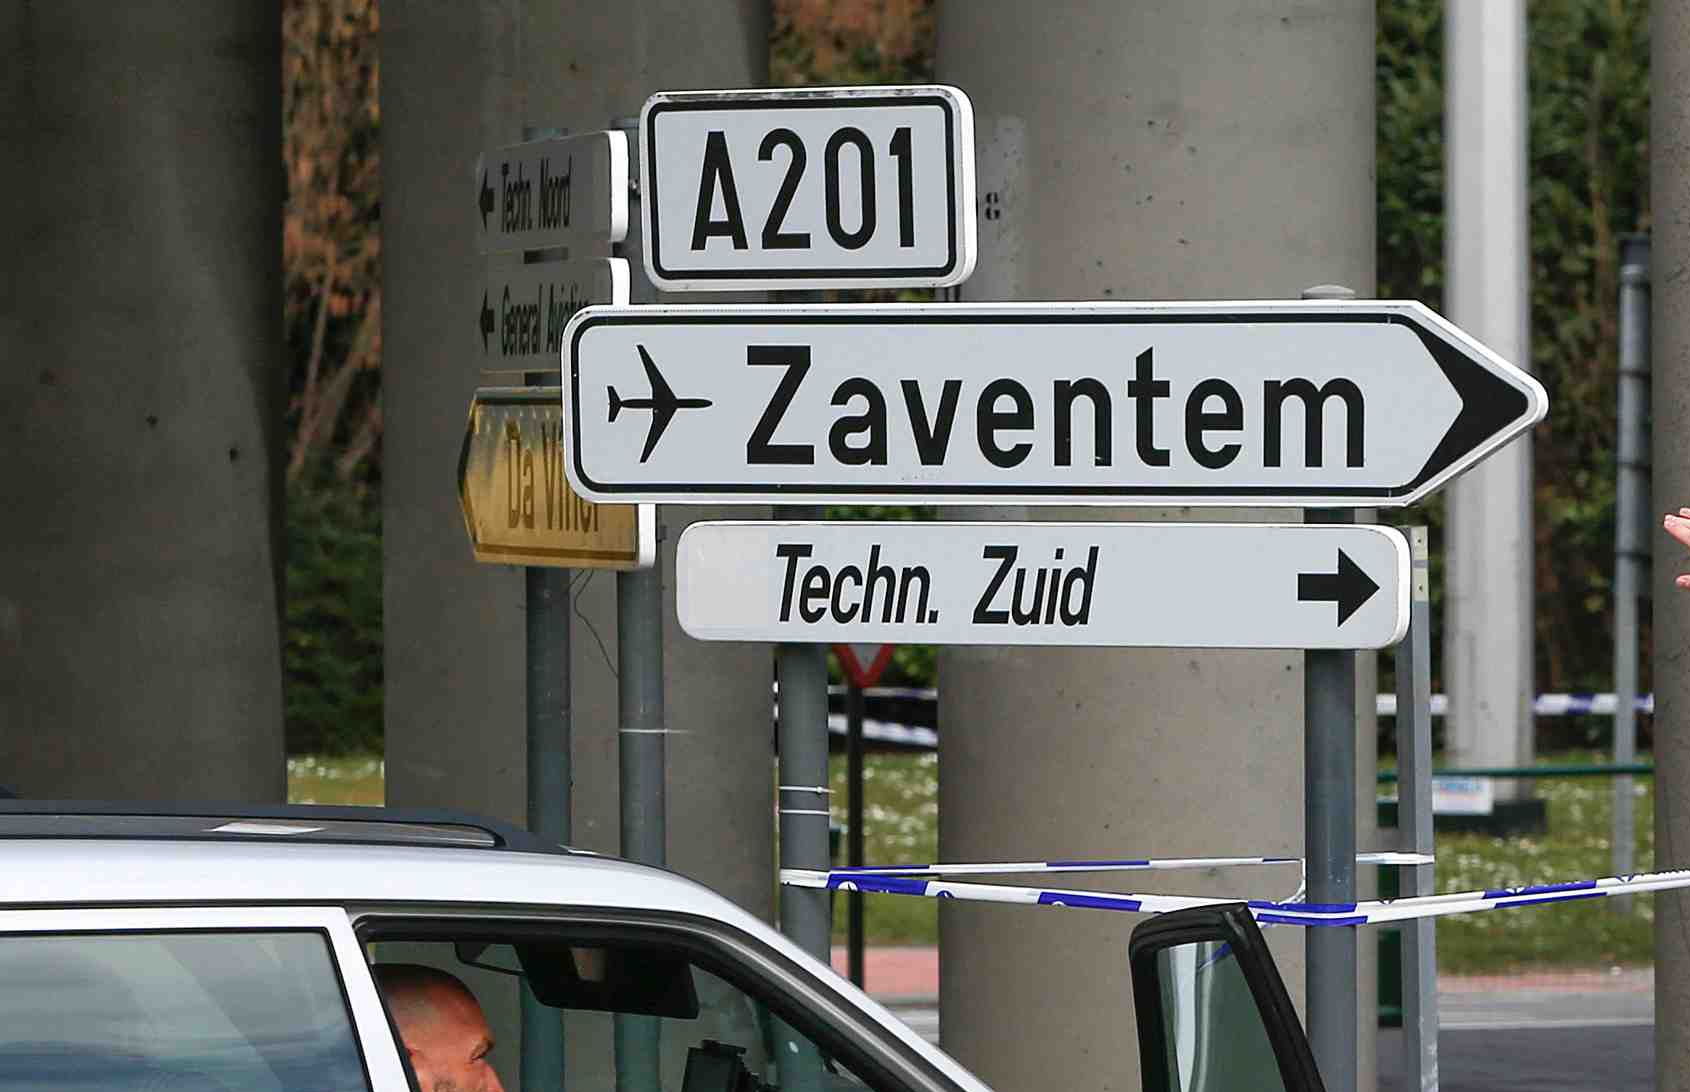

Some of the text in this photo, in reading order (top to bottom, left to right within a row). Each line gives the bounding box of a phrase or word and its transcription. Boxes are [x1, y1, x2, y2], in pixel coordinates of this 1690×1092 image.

[690, 126, 915, 251] A201
[746, 345, 1365, 469] Zaventem
[775, 543, 1100, 627] Techn. Zuid
